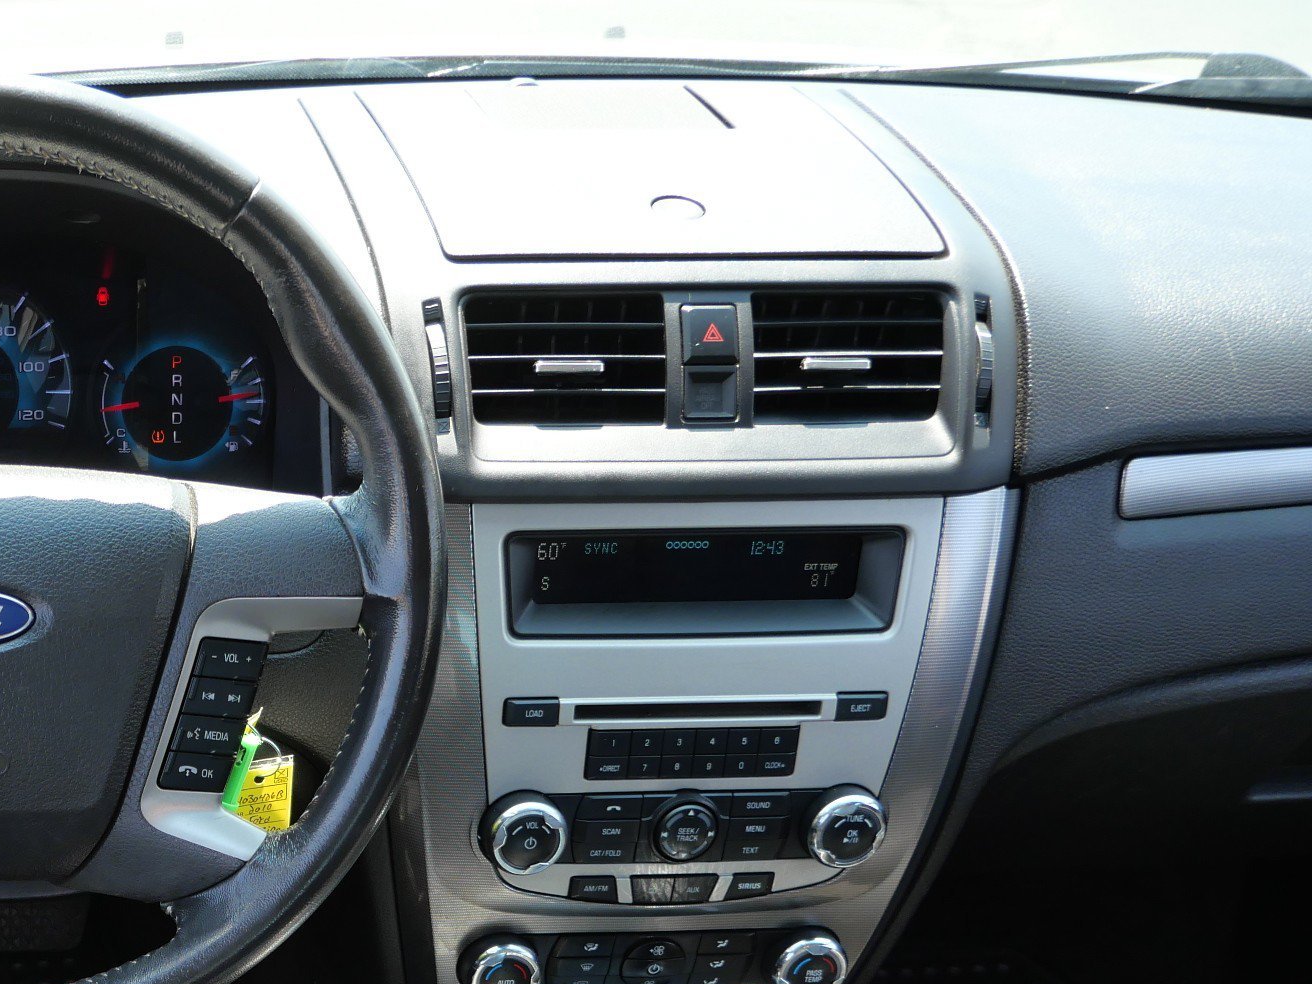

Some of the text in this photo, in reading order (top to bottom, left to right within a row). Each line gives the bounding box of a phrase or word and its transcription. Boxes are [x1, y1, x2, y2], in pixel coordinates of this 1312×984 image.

[172, 356, 182, 368] P
[18, 361, 45, 373] 100
[172, 374, 182, 387] R
[172, 393, 183, 406] N
[18, 410, 44, 421] 120
[172, 412, 182, 424] D
[116, 428, 126, 438] C
[173, 431, 182, 443] L
[584, 542, 618, 555] SYNC
[750, 540, 784, 555] 12:43
[804, 563, 838, 571] EXT TEMP
[224, 653, 239, 664] VOL
[850, 704, 872, 713] EJECT
[525, 709, 544, 718] LOAD
[203, 730, 229, 742] MEDIA
[644, 739, 650, 747] 2
[676, 738, 682, 746] 3
[709, 737, 716, 745] 4
[741, 737, 748, 745] 5
[674, 763, 680, 771] 8
[706, 762, 712, 770] 9
[201, 768, 214, 779] OK
[746, 801, 771, 810] SOUND
[846, 814, 864, 823] TUNE
[525, 821, 539, 830] VOL
[745, 825, 766, 833] MENU
[601, 828, 621, 836] SCAN
[846, 829, 859, 837] OK
[676, 834, 699, 842] TRACK
[741, 846, 759, 854] TEXT
[583, 884, 609, 893] AM/FM
[686, 886, 700, 894] AUX
[737, 882, 762, 890] SIRIUS
[806, 969, 823, 977] PASS
